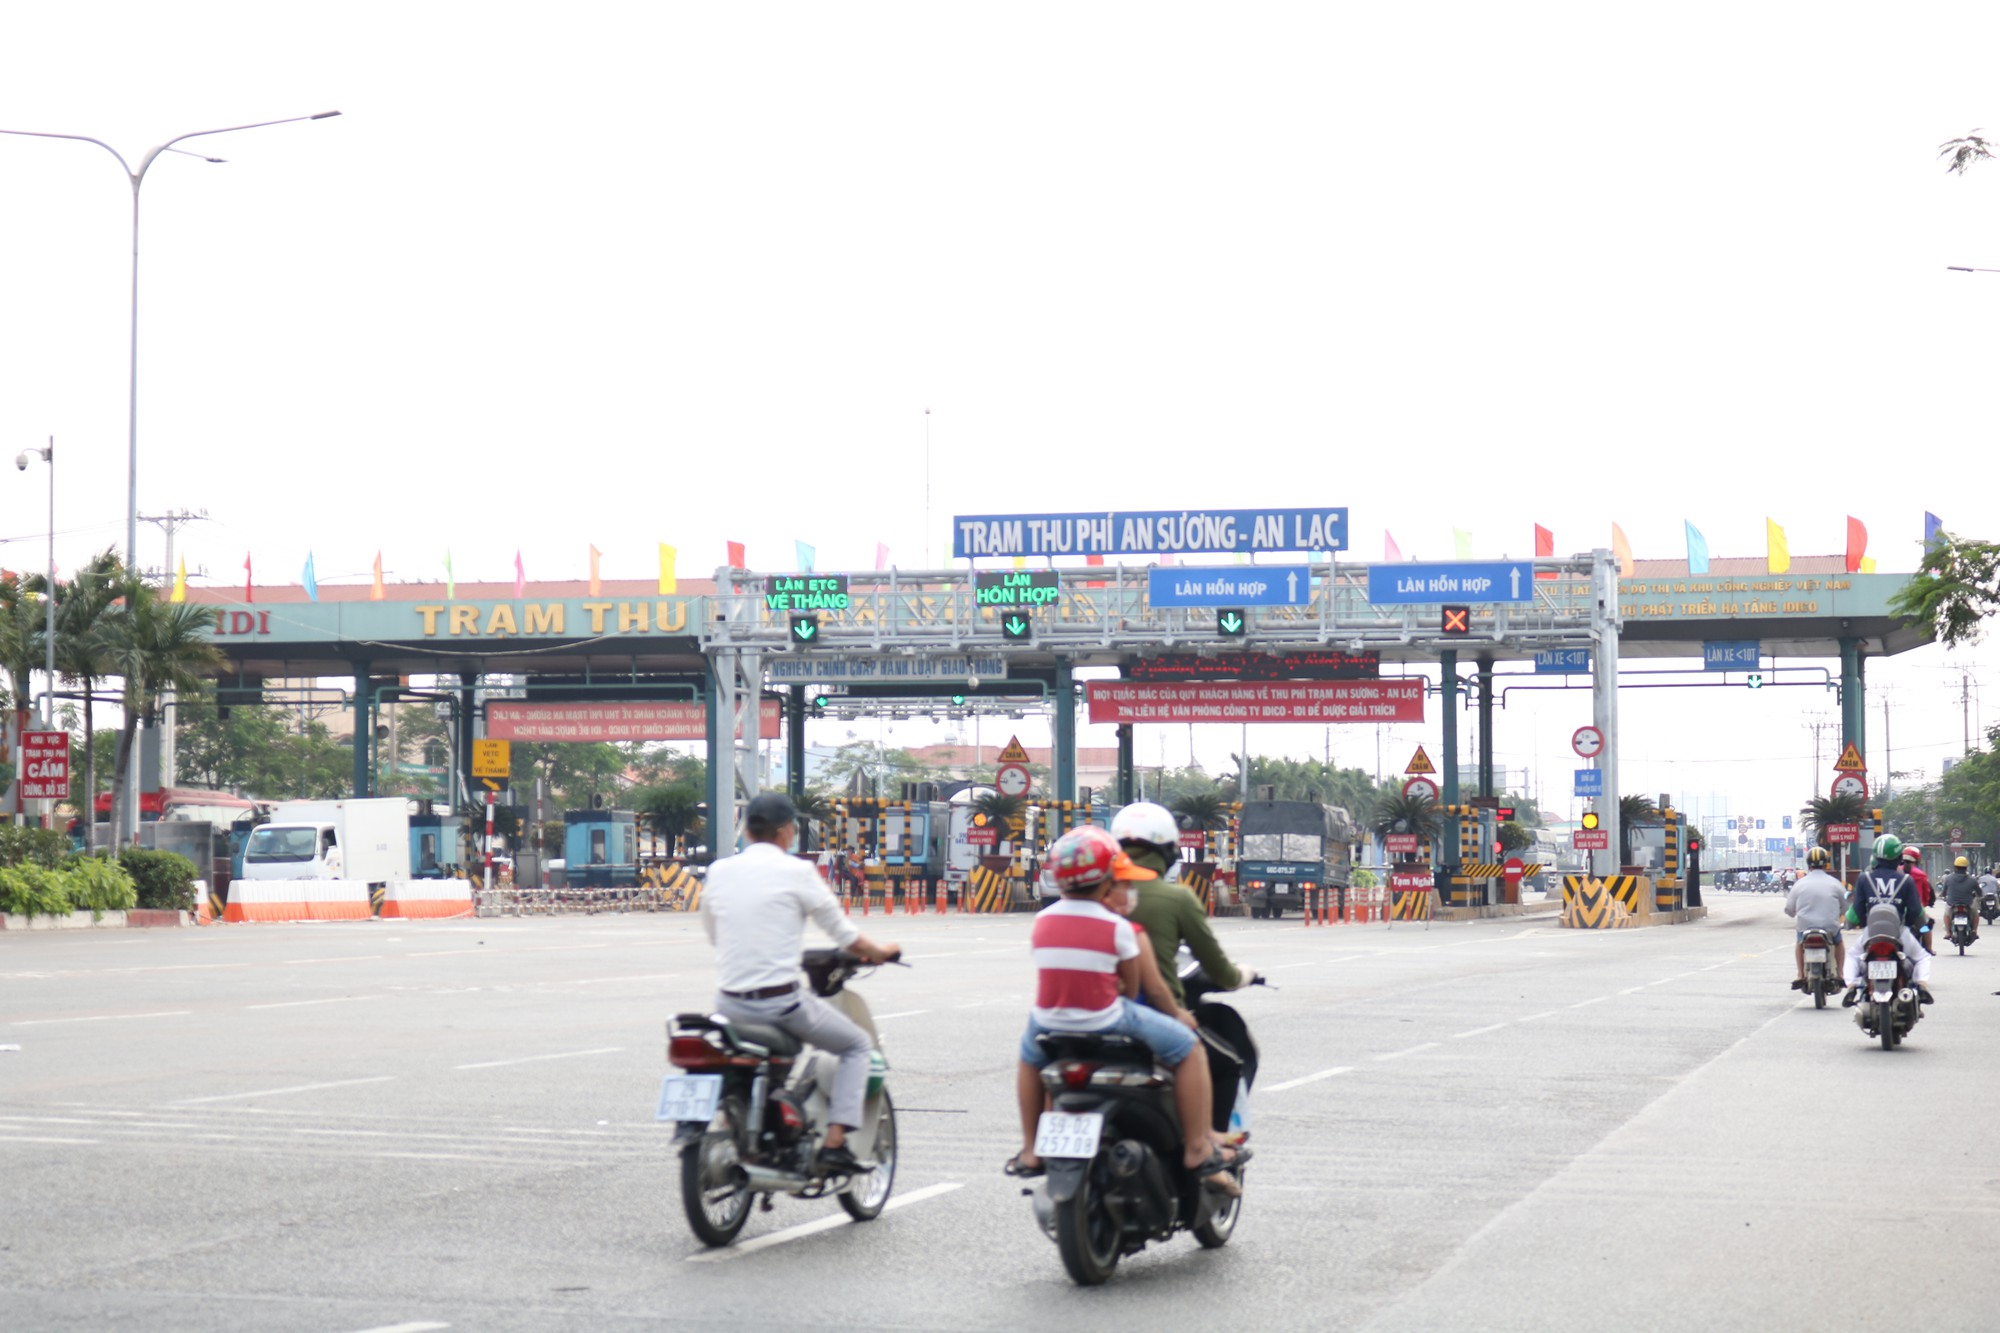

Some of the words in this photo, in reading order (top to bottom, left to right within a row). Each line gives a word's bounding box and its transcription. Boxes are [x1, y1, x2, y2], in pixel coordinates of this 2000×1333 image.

[959, 521, 1022, 557] TRẠM
[1028, 519, 1073, 552] THU
[1076, 512, 1113, 551] PHÍ
[1121, 518, 1153, 551] AN
[1157, 512, 1236, 551] SƯƠNG
[1251, 515, 1284, 548] AN
[1295, 513, 1340, 551] LẠC
[775, 577, 804, 591] LÀN
[809, 579, 837, 591] ETC
[1003, 573, 1031, 587] LÀN
[1174, 577, 1202, 596] LÀN
[1205, 576, 1234, 596] HỖN
[1238, 580, 1267, 599] HỢP
[1397, 575, 1425, 593] LÀN
[1429, 573, 1458, 593] HỖN
[1462, 577, 1491, 596] HỢP
[1690, 582, 1713, 592] KHU
[1717, 579, 1748, 591] CÔNG
[1796, 579, 1822, 595] VIỆT
[1825, 579, 1851, 591] NAM
[767, 589, 791, 610] VÉ
[791, 588, 848, 610] THÁNG
[976, 584, 1015, 604] HỖN
[1018, 586, 1058, 608] HỢP
[1641, 601, 1674, 615] PHÁT
[1680, 597, 1716, 616] TRIỂN
[1721, 603, 1740, 617] HẠ
[1782, 602, 1818, 613] IDICO
[415, 603, 564, 639] TRẠM
[582, 601, 686, 633] THU
[1554, 653, 1564, 665] XE
[1707, 646, 1723, 662] LÀN
[1724, 649, 1735, 661] XE
[941, 658, 965, 675] GIAO
[1159, 686, 1177, 700] CỦA
[1200, 686, 1229, 700] KHÁCH
[1231, 686, 1255, 700] HÀNG
[1271, 688, 1288, 699] THU
[1291, 686, 1306, 699] PHÍ
[1308, 688, 1333, 701] TRẠM
[1335, 688, 1348, 699] AN
[1350, 687, 1379, 699] SƯƠNG
[1387, 688, 1399, 698] AN
[1401, 687, 1419, 701] LẠC
[1118, 705, 1134, 717] XIN
[1223, 703, 1247, 717] CÔNG
[1248, 705, 1260, 716] TY
[1262, 705, 1286, 716] IDICO
[1294, 705, 1305, 716] IDI
[1369, 702, 1395, 716] THÍCH
[30, 736, 43, 744] KHU
[43, 748, 55, 758] THU
[27, 759, 64, 778] CẤM
[57, 783, 66, 795] XE
[1875, 877, 1897, 895] M
